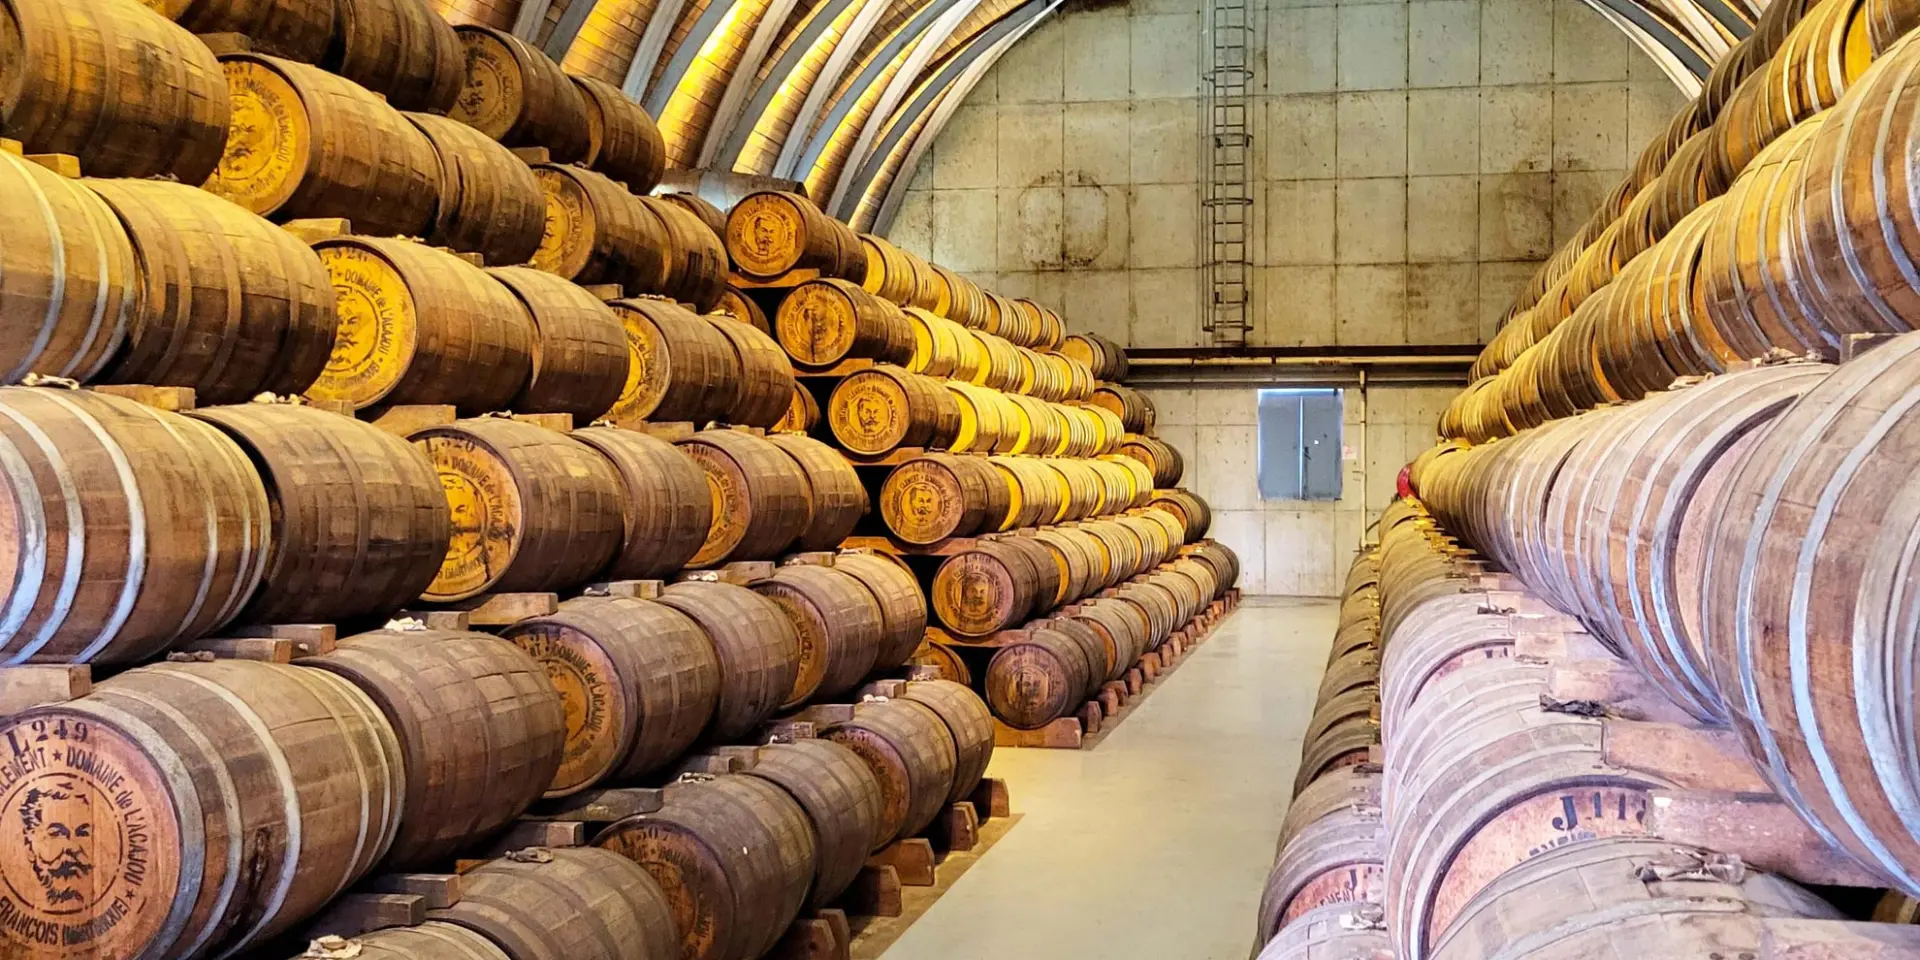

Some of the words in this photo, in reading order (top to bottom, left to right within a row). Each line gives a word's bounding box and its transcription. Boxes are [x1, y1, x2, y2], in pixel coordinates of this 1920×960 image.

[0, 747, 46, 796] LEMENT
[66, 746, 124, 793] DOMAINE
[115, 790, 133, 809] de
[123, 808, 148, 886] L'ACAJOU
